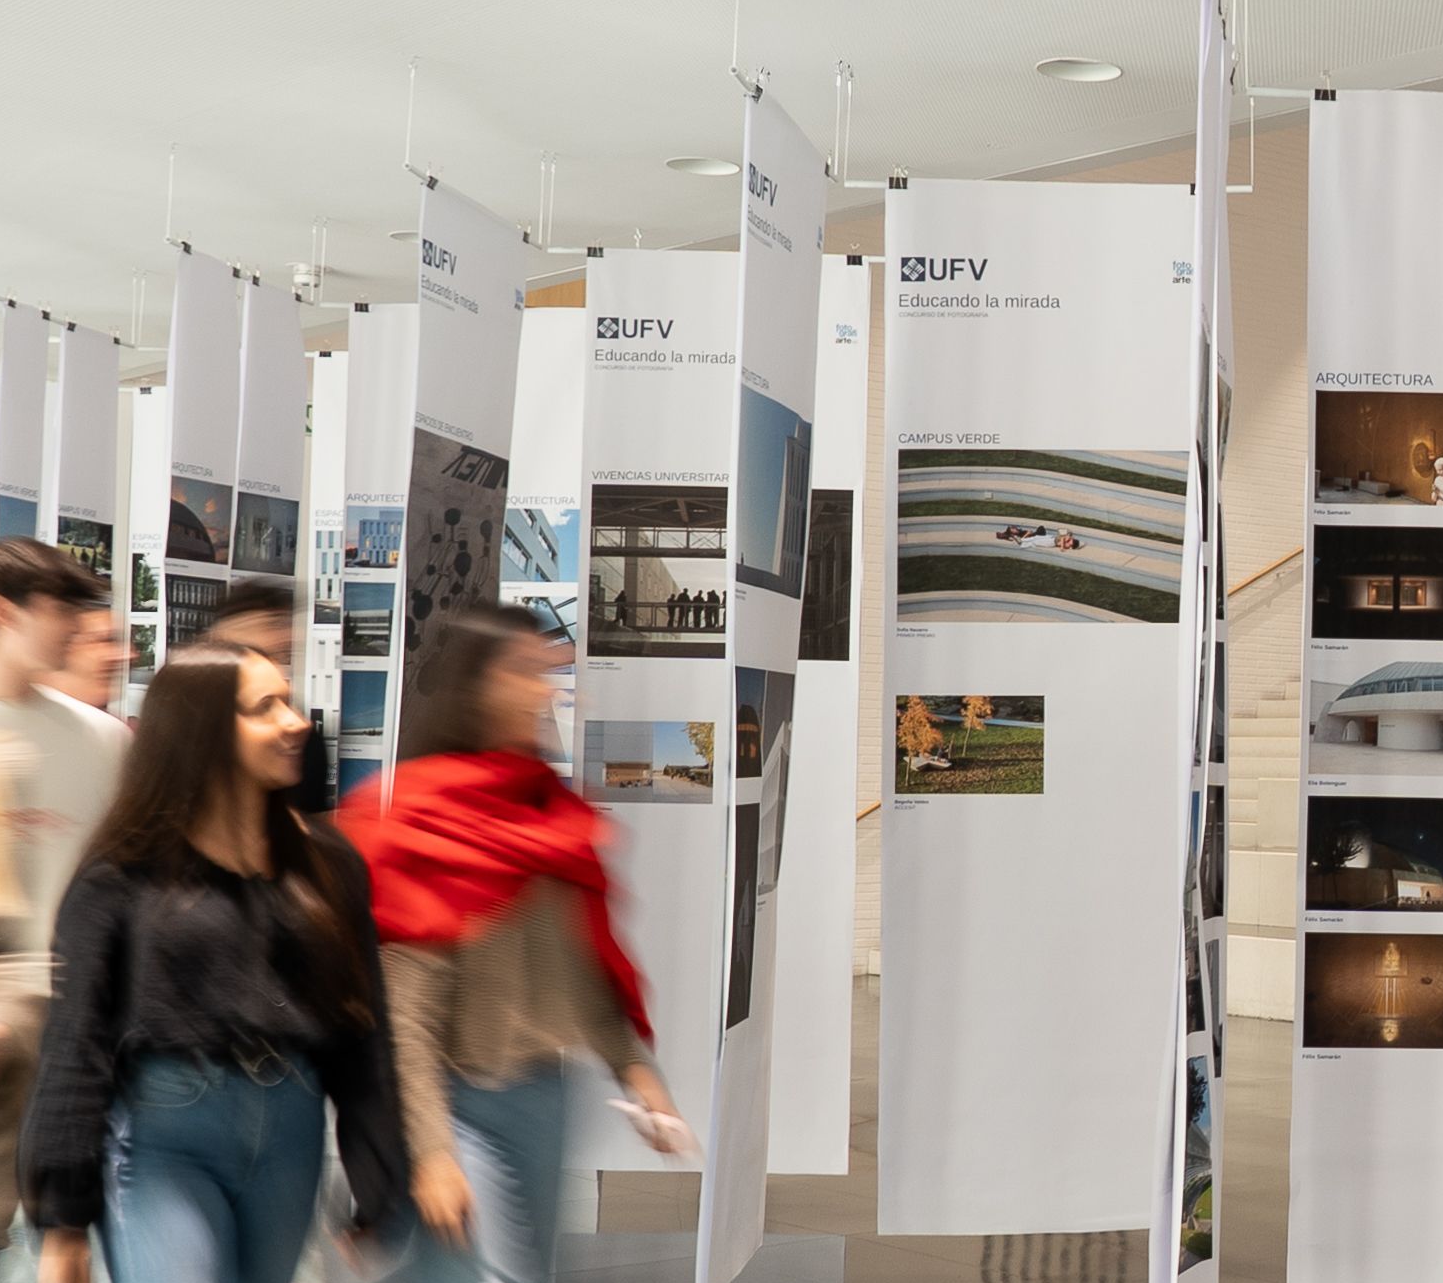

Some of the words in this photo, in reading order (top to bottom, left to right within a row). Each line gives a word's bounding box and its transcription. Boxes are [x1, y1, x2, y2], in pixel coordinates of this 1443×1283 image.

[757, 170, 778, 207] UFV
[434, 245, 457, 275] UFV
[929, 258, 988, 281] UFV
[898, 293, 980, 309] Educando
[985, 294, 999, 309] la
[1005, 294, 1061, 309] mirada
[622, 319, 674, 339] UFV
[595, 349, 666, 363] Educando
[671, 351, 683, 363] la
[688, 351, 736, 364] mirada
[1315, 373, 1434, 388] ARQUITECTURA
[898, 433, 953, 445] CAMPUS
[956, 433, 1000, 445] VERDE
[592, 470, 651, 481] VIVENCIAS
[654, 472, 730, 483] UNIVERSITAR
[347, 493, 405, 503] ARQUITECT
[507, 496, 575, 505] QUITECTURA
